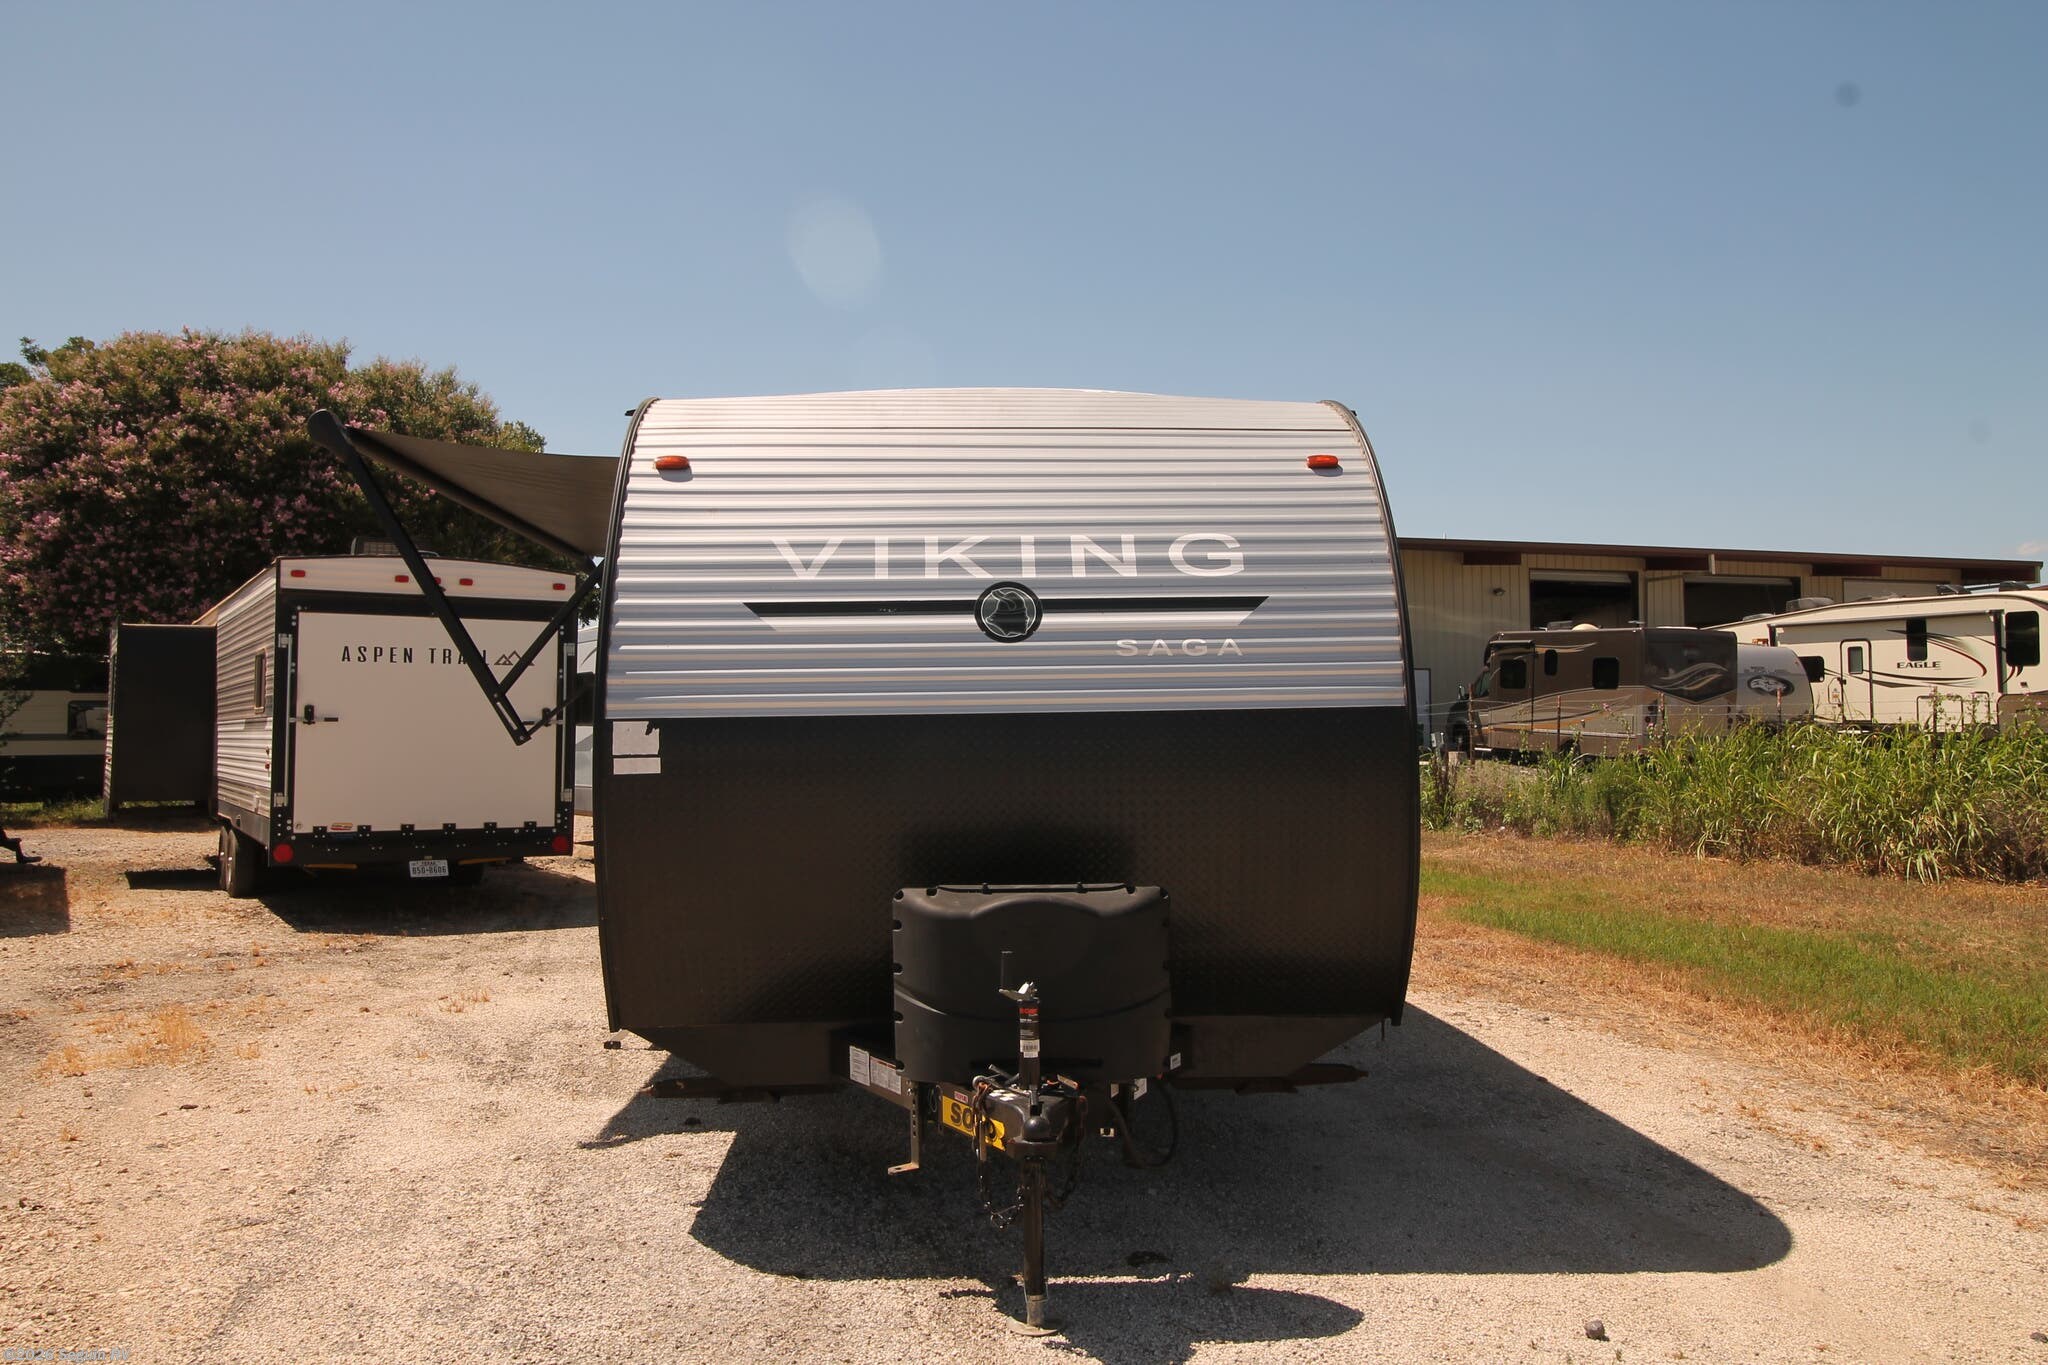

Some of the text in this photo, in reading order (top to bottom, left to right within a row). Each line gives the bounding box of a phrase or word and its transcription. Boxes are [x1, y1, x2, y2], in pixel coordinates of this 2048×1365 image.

[770, 533, 1245, 579] VIKING
[341, 646, 489, 665] ASPEN TRAL
[1116, 638, 1243, 657] SAGA
[1896, 660, 1942, 669] EAGLE
